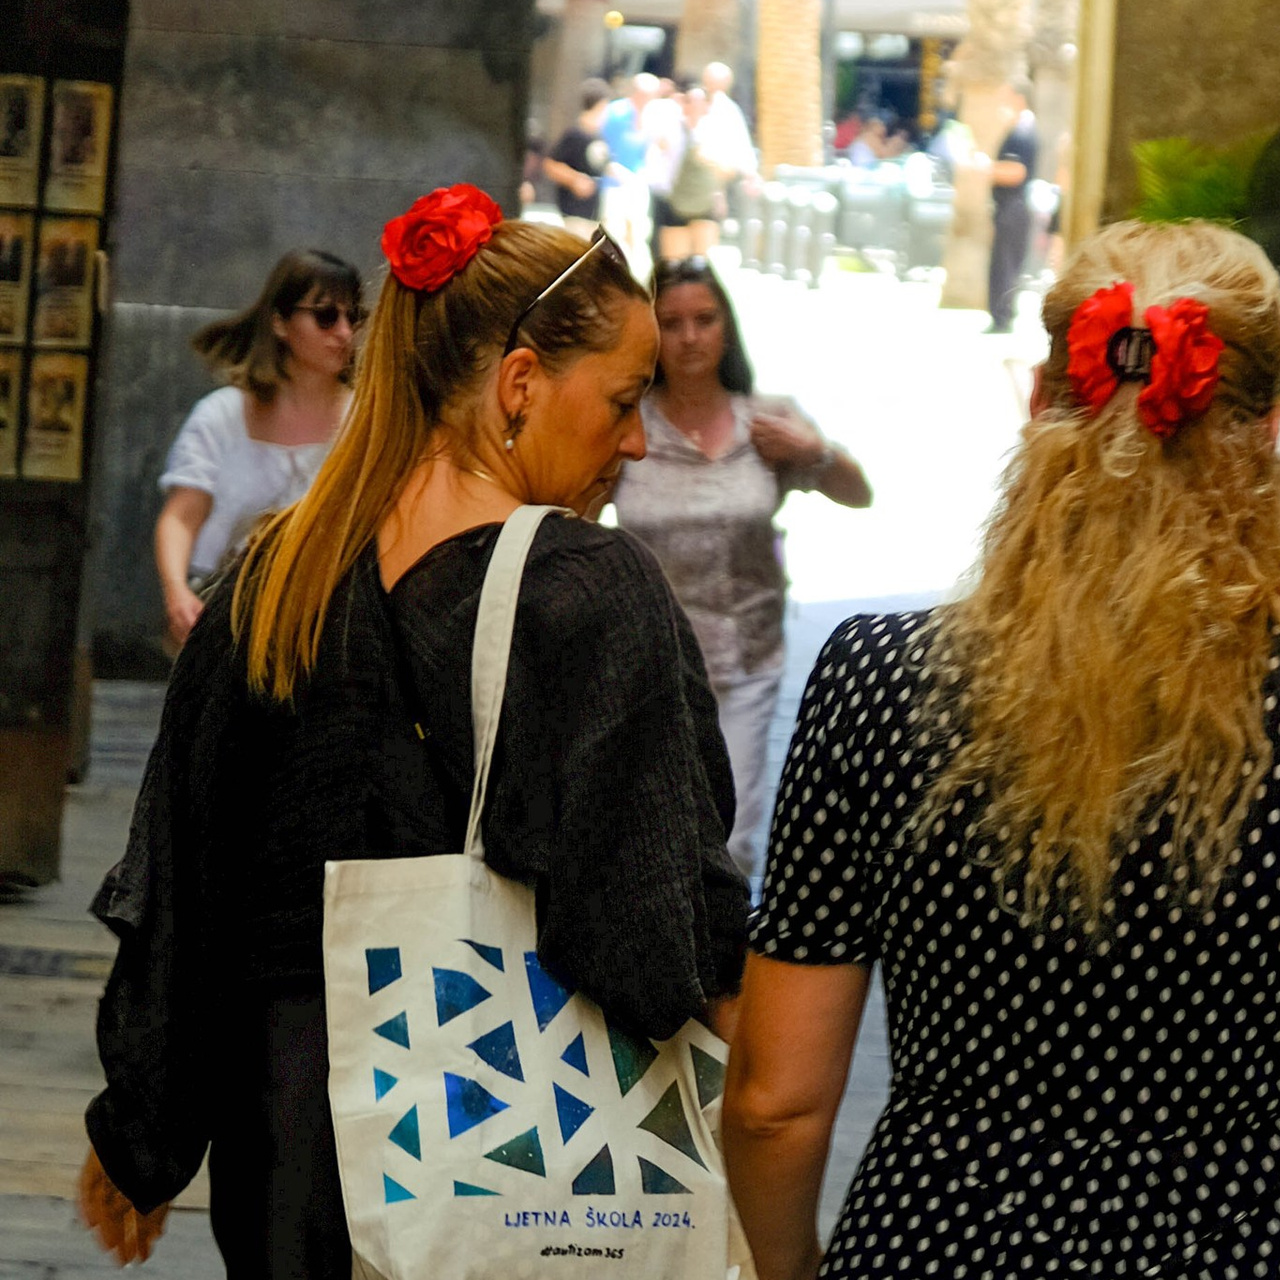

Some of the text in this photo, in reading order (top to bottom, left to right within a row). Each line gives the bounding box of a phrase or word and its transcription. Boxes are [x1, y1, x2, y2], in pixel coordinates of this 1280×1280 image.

[504, 1206, 696, 1229] LJETNA ŠKOLA 2024.
